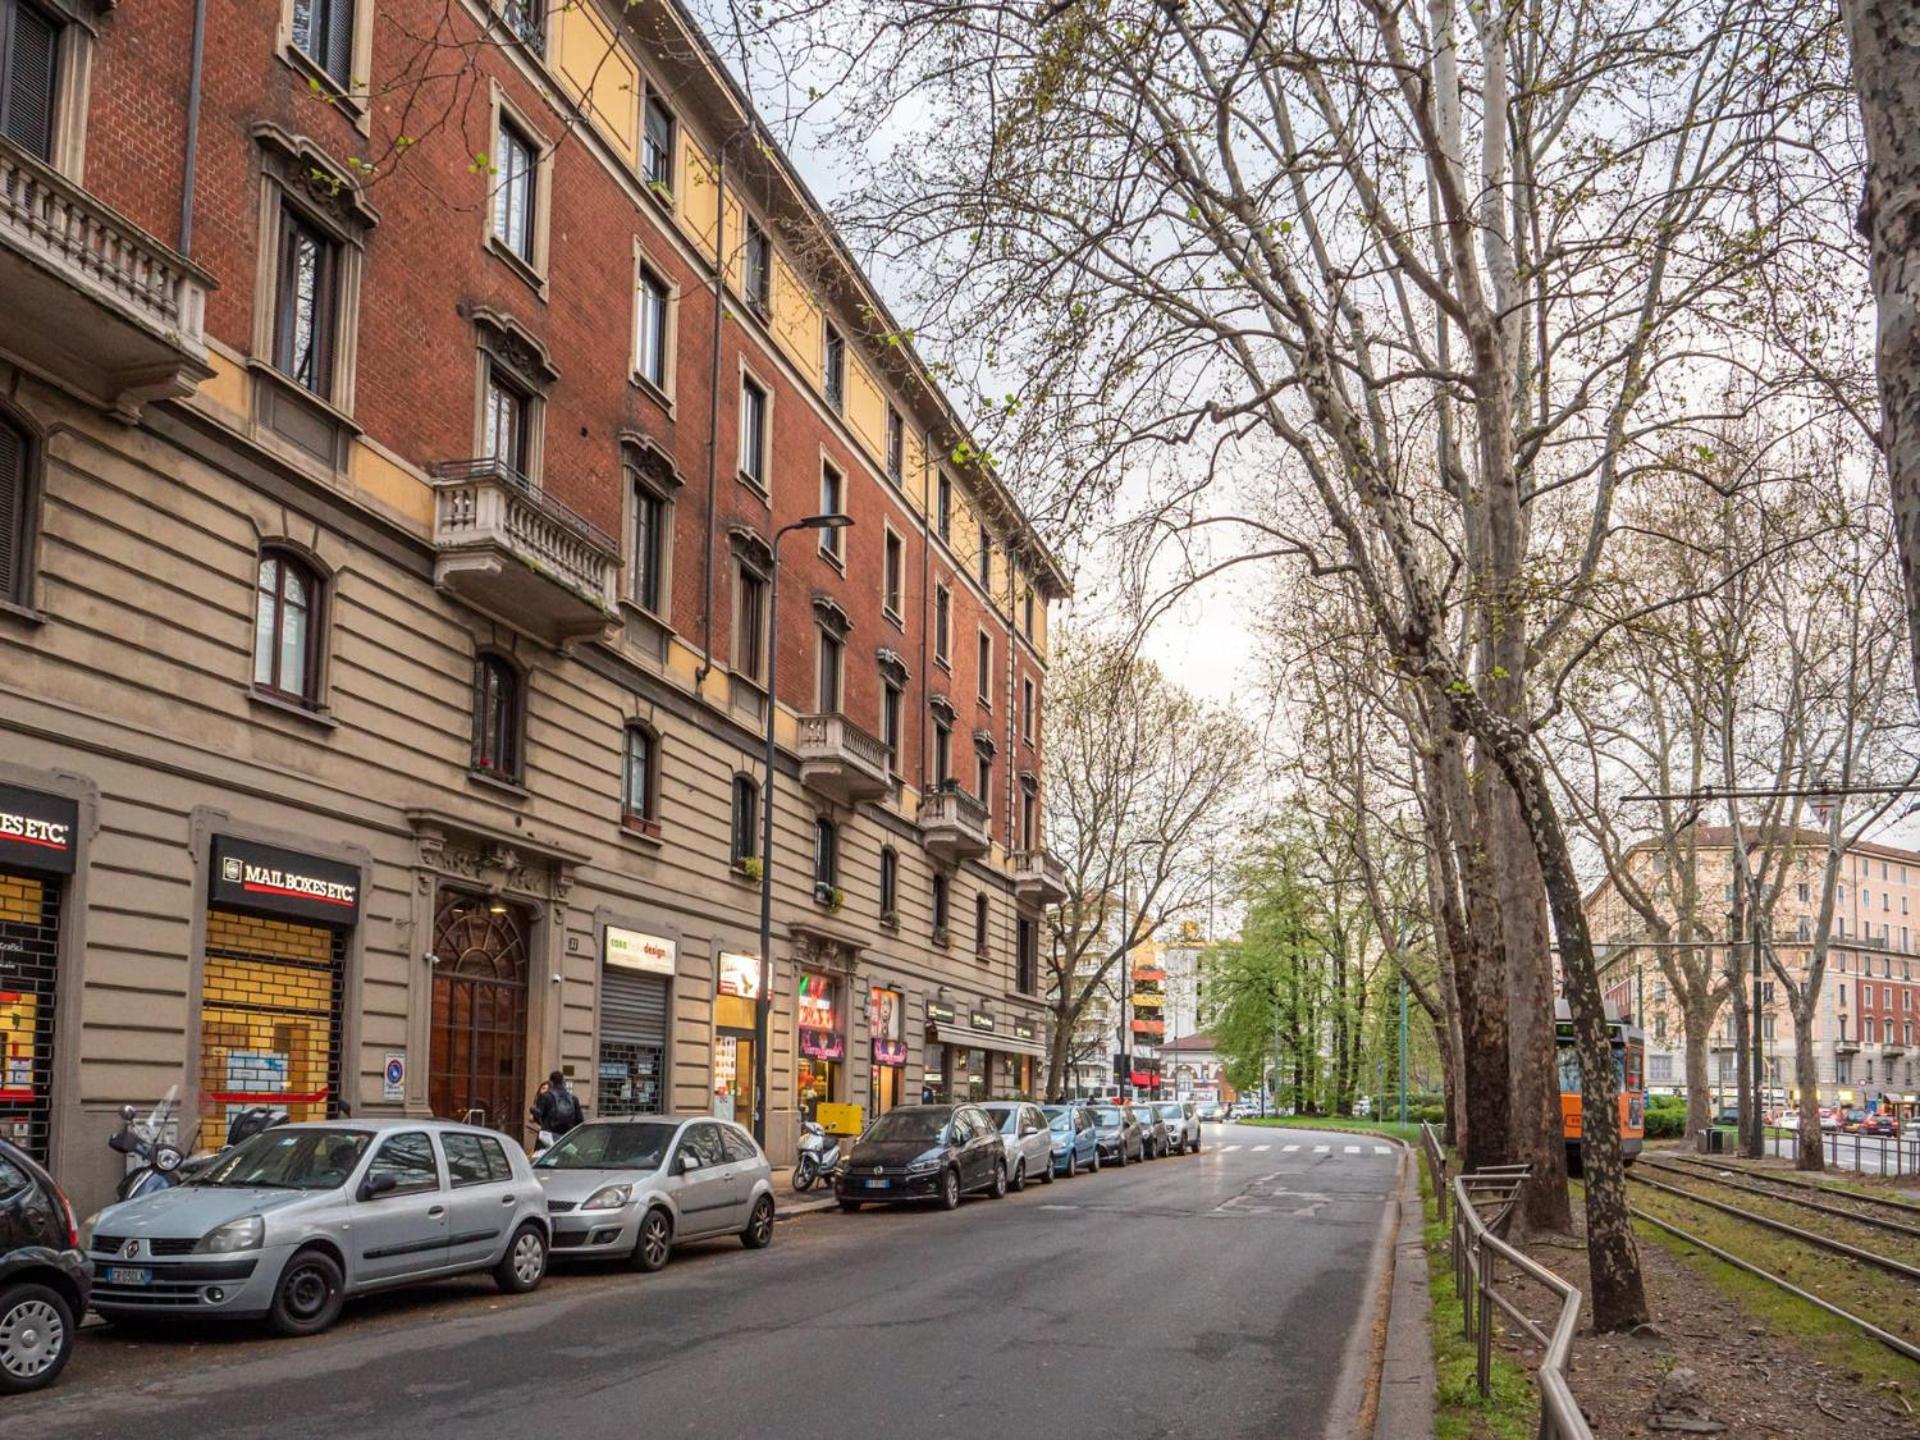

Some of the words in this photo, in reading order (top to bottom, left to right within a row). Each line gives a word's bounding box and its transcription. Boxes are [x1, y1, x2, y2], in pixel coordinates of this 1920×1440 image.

[0, 812, 24, 836] ES
[245, 865, 284, 888] MAIL
[286, 873, 327, 896] BOXES
[643, 942, 667, 959] design
